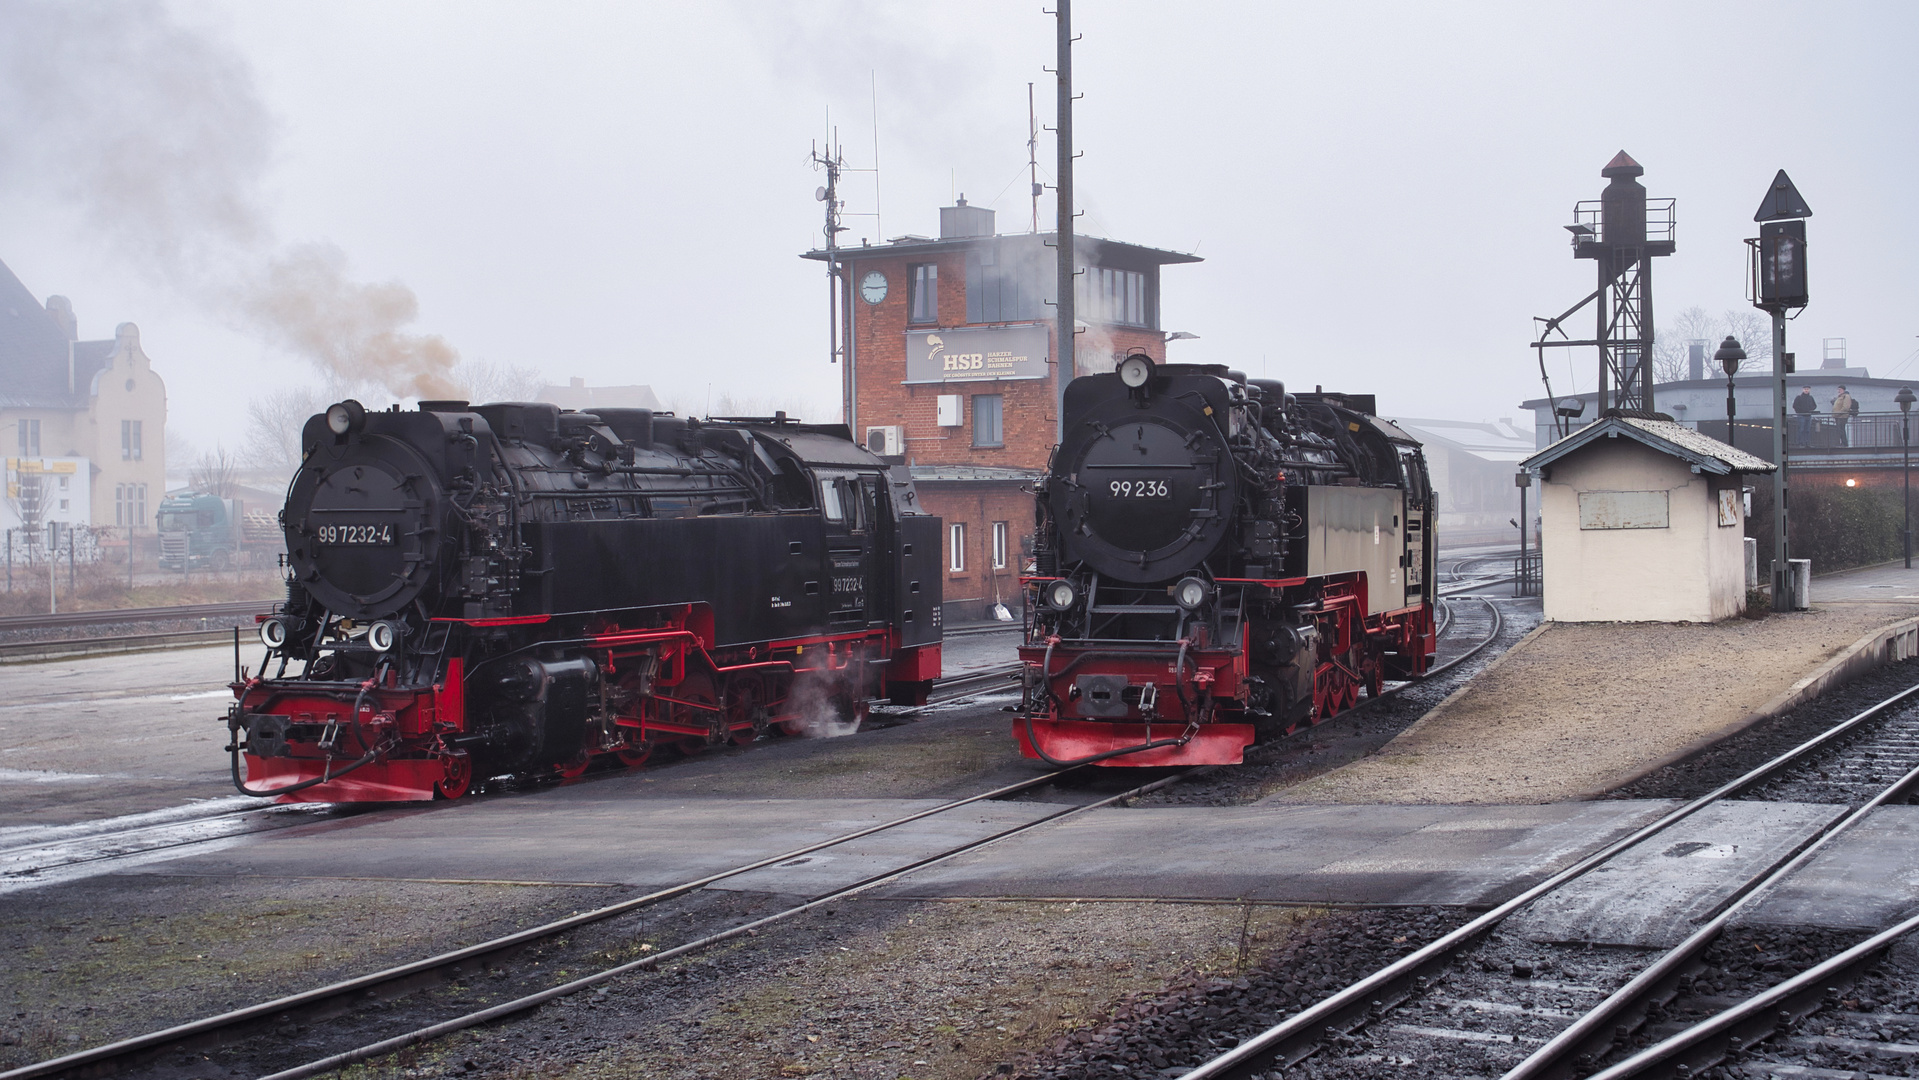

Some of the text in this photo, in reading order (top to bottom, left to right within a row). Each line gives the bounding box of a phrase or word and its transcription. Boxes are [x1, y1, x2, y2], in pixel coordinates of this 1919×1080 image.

[944, 354, 983, 370] HSB
[1110, 481, 1168, 497] 99 236
[319, 526, 391, 543] 99 7232-4
[834, 578, 862, 592] 99 7232-4
